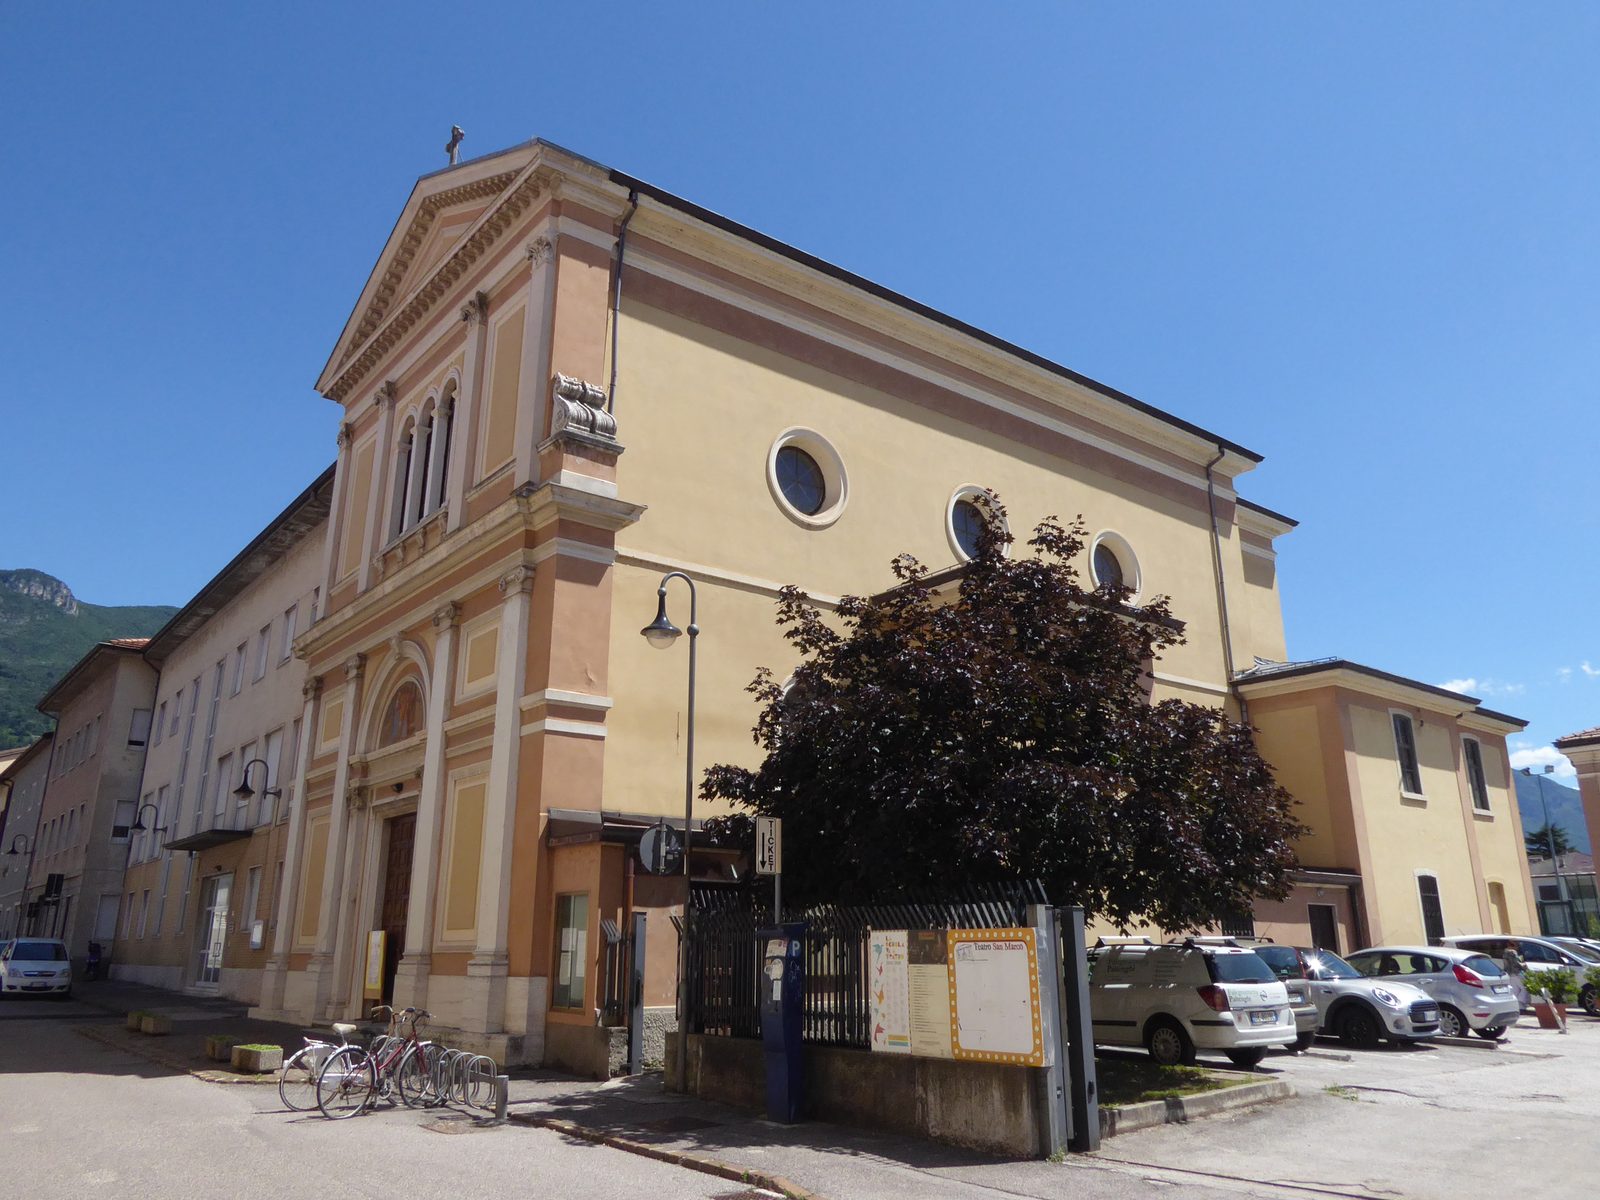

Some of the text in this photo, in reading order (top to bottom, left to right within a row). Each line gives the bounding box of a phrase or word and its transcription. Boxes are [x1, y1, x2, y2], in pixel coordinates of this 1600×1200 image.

[767, 820, 775, 872] TICKET
[792, 940, 801, 957] P
[973, 942, 1024, 951] Teatro San Marco
